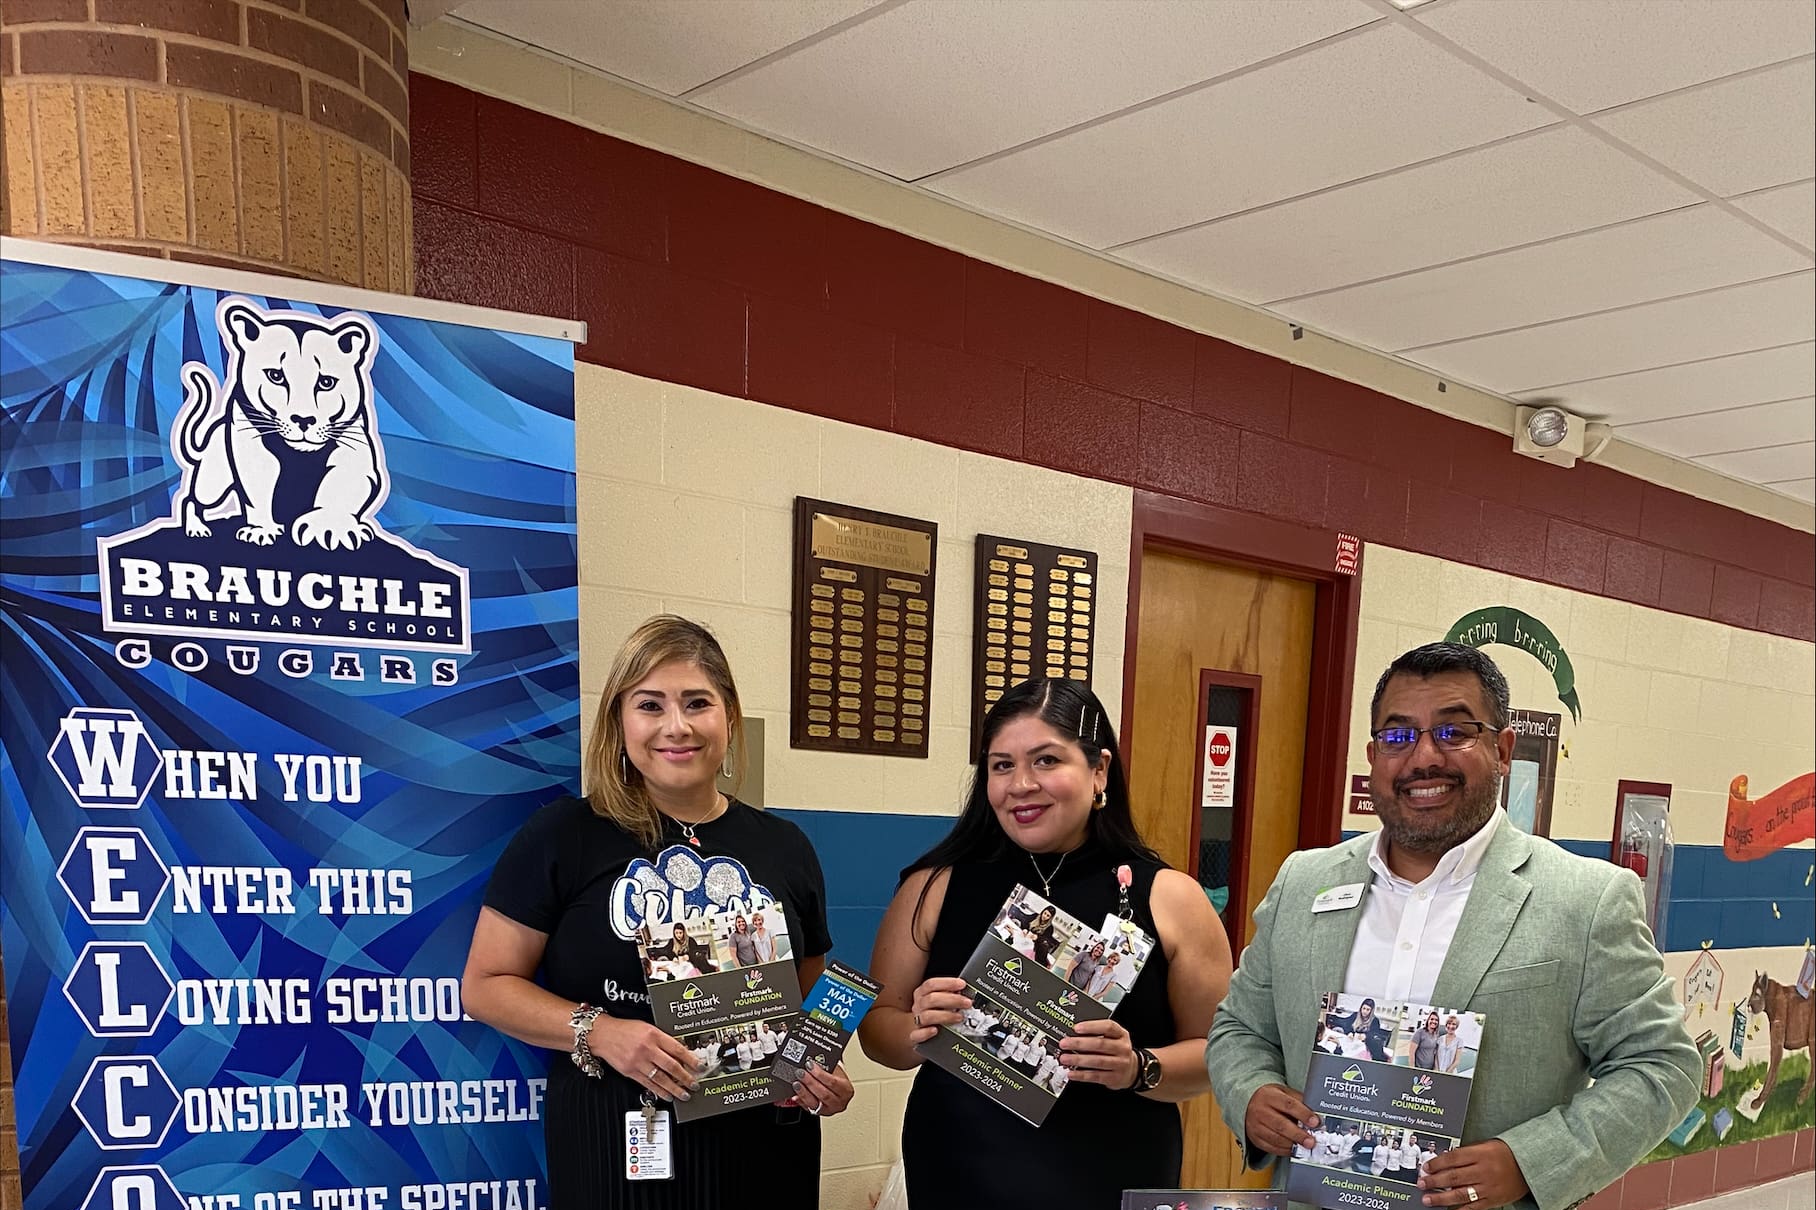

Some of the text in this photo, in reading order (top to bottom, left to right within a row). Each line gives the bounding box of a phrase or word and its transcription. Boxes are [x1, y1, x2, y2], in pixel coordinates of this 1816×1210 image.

[120, 557, 453, 618] BRAUCHLE
[124, 603, 455, 639] ELEMENTARY SCHOOL
[115, 639, 458, 687] COUGARS
[59, 717, 363, 803] WHEN YOU
[1210, 744, 1230, 755] STOP
[85, 836, 414, 916] ENTER THIS
[985, 958, 1031, 994] Firstmark
[986, 970, 1005, 987] Credit
[93, 952, 475, 1028] LOVING SCHOO
[604, 978, 652, 1005] Brau
[734, 991, 783, 1008] FOUNDATION
[740, 985, 773, 999] Firstmark
[827, 987, 856, 1008] MAX
[669, 994, 720, 1013] Firstmark
[676, 1008, 696, 1019] Credit
[818, 997, 850, 1019] 3.00
[1035, 1000, 1075, 1029] FOUNDATIO
[1046, 998, 1076, 1021] Firstmark
[674, 1020, 694, 1032] Rooted
[694, 1019, 701, 1027] in
[730, 1009, 752, 1021] Powered
[753, 1008, 761, 1018] by
[761, 1003, 787, 1014] Members
[816, 1013, 837, 1026] NEW!
[951, 1042, 1024, 1092] Academic Planner
[960, 1061, 1002, 1093] 2023-2024
[703, 1074, 774, 1098] Academic Plan
[723, 1088, 770, 1106] 2023-2024
[1324, 1076, 1379, 1097] Firstmark
[1328, 1089, 1349, 1099] Credit
[103, 1064, 547, 1140] CONSIDER YOURSELF
[1391, 1099, 1445, 1116] FOUNDATION
[1401, 1093, 1437, 1106] Firstmark
[1319, 1100, 1342, 1111] Rooted
[1342, 1104, 1349, 1112] in
[1381, 1111, 1407, 1122] Powered
[1407, 1115, 1416, 1125] by
[1416, 1117, 1444, 1129] Members
[1321, 1175, 1411, 1202] Academic Planner
[1338, 1192, 1390, 1210] 2023-2024
